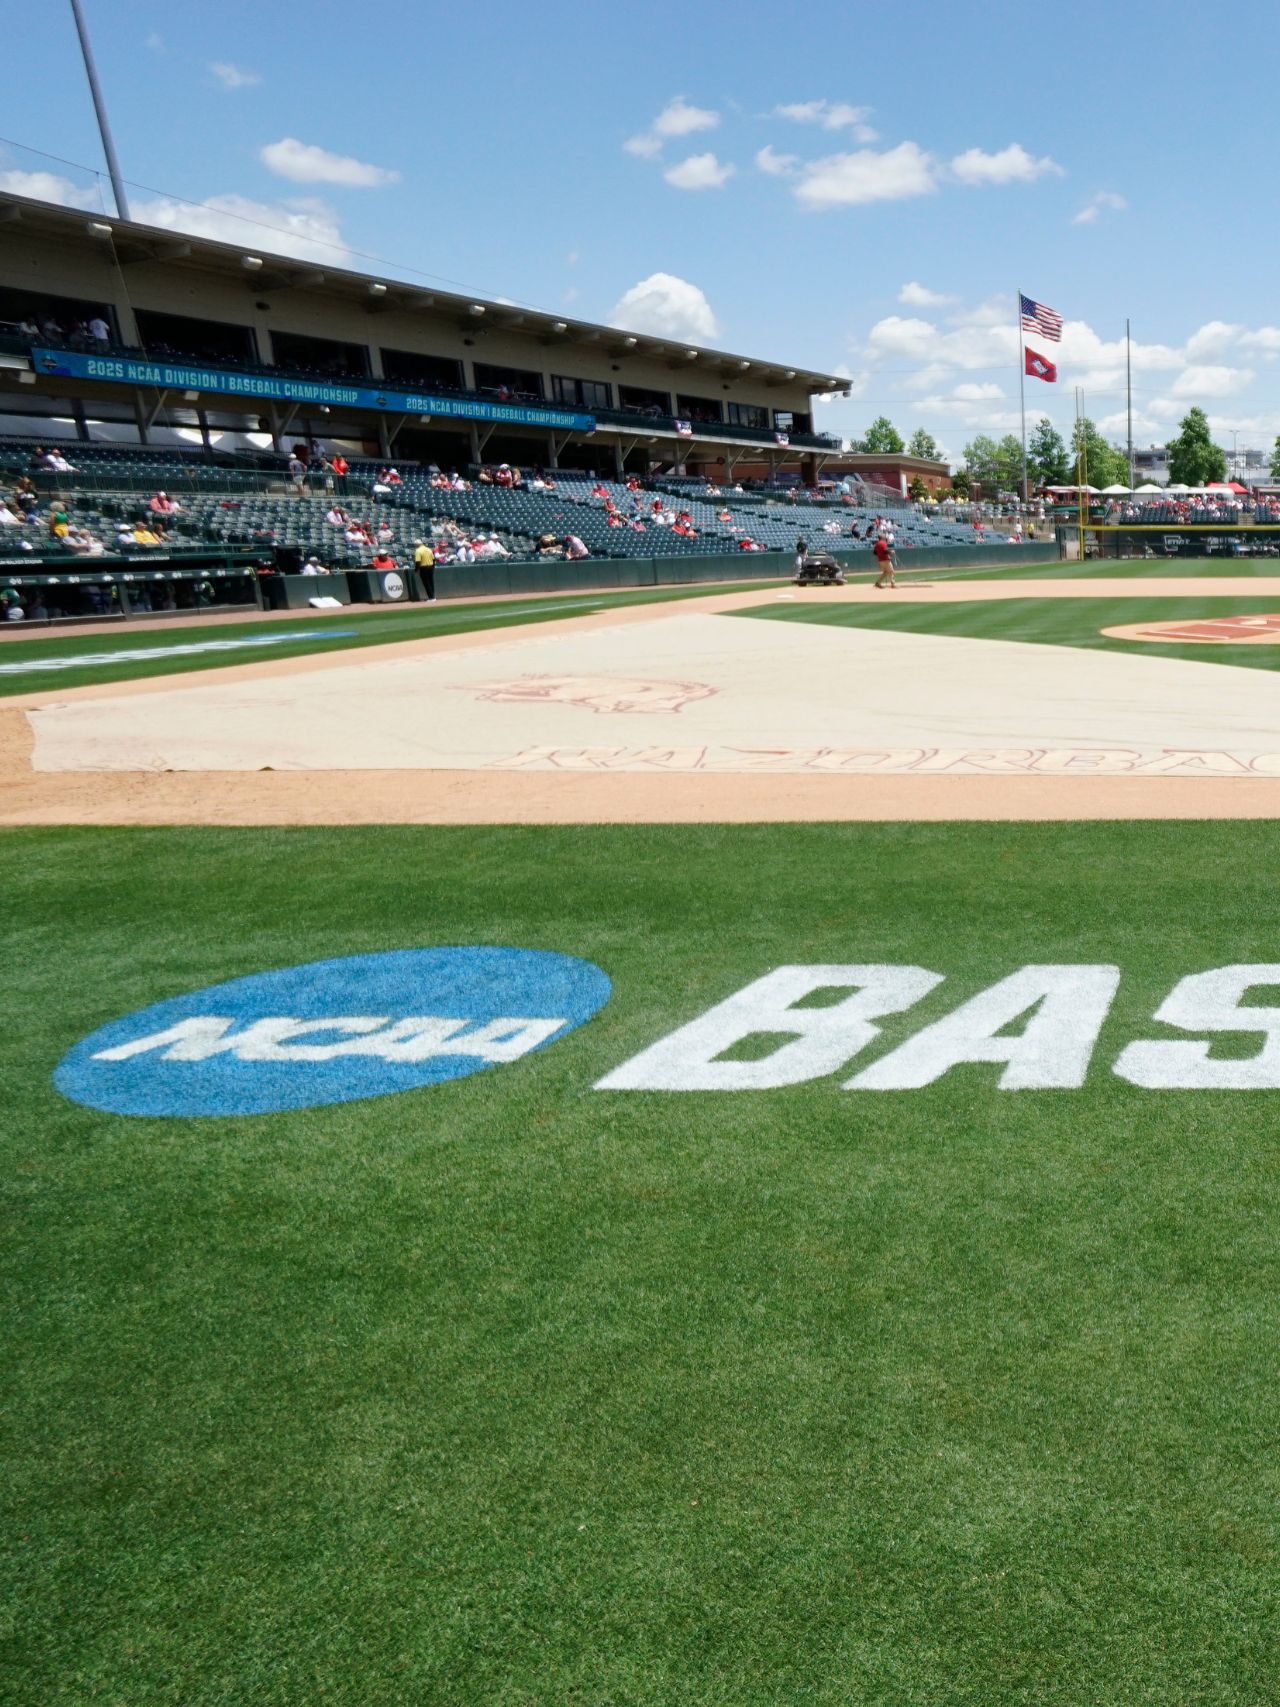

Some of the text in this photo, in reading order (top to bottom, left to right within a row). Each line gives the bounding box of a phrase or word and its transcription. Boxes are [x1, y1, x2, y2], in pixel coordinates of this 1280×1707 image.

[87, 360, 124, 378] 2025
[128, 364, 161, 382] NCAA
[165, 369, 218, 389] DIVISION
[229, 376, 281, 395] BASEBALL
[284, 383, 358, 403] CHAMPIONSHIP
[406, 398, 428, 410] 2025
[430, 401, 450, 412] NCAA
[453, 404, 485, 417] DIVISION
[492, 407, 525, 421] BASEBALL
[527, 411, 576, 426] CHAMPIONSHIP
[388, 584, 403, 592] NCAA
[91, 1016, 567, 1063] NCAA
